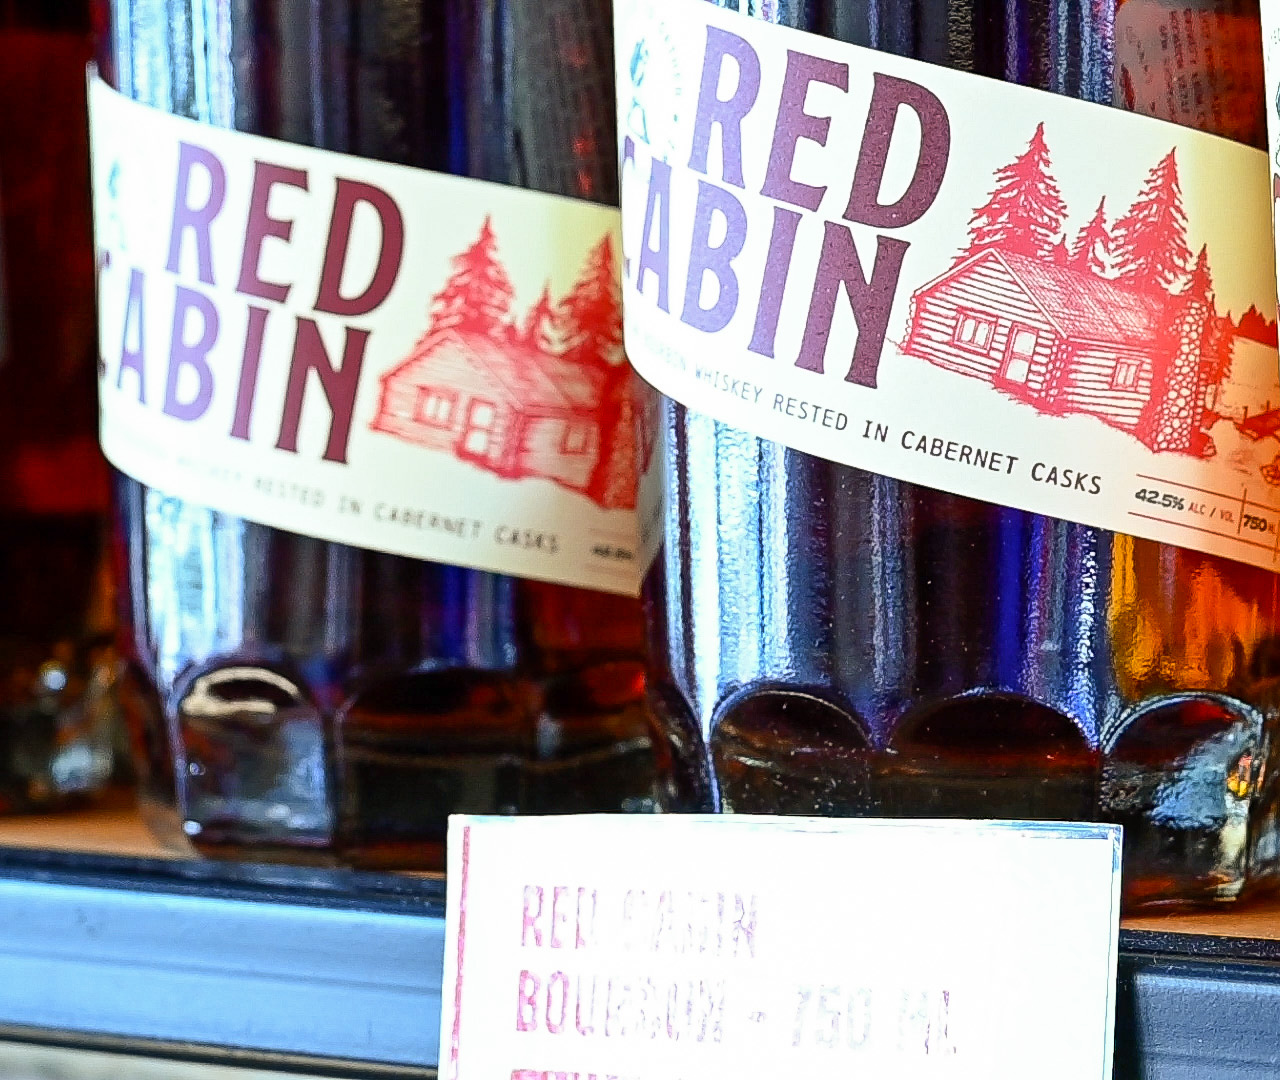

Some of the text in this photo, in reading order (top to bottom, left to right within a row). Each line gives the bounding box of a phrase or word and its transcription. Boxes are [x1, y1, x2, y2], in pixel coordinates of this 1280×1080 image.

[688, 24, 950, 230] RED
[165, 140, 405, 318] RED
[623, 135, 910, 389] ABIN
[101, 250, 371, 465] ABIN
[695, 363, 763, 404] WHISKEY
[773, 394, 847, 430] RESTED
[862, 420, 888, 442] IN
[901, 430, 1018, 474] CABERNET
[1031, 462, 1101, 495] CASKS
[338, 493, 361, 514] IN
[1135, 489, 1184, 511] 42.5%
[1188, 503, 1205, 516] ALC
[521, 885, 597, 949] RED
[792, 984, 873, 1051] 750
